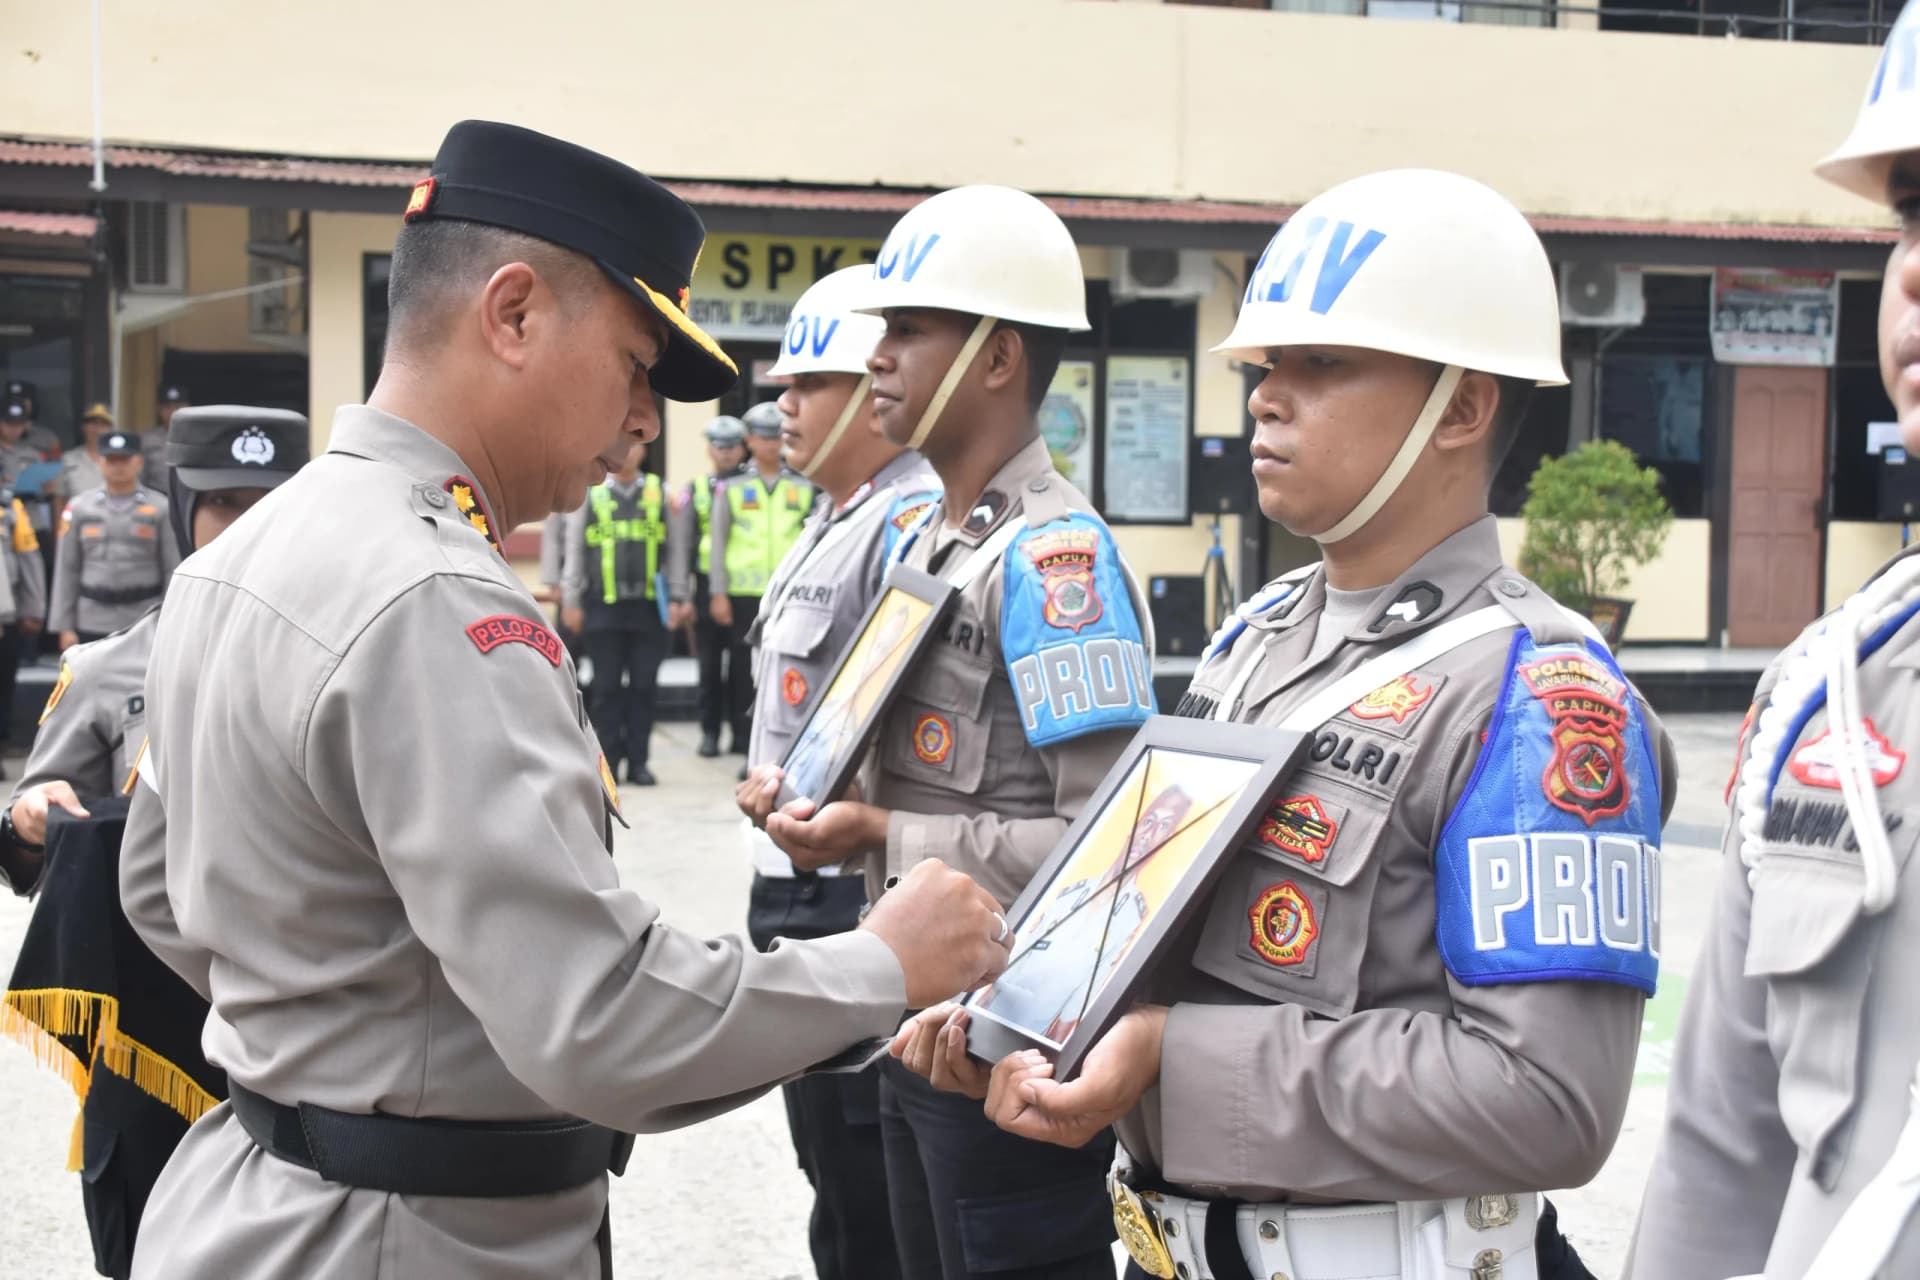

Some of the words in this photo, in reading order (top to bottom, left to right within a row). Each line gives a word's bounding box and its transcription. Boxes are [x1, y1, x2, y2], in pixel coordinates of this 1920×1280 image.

[1042, 553, 1090, 569] PAPUA
[475, 620, 557, 657] PELOPOR
[1010, 638, 1152, 731] PROV
[1536, 674, 1588, 692] JAYAPURA
[1554, 700, 1617, 720] PAPUA
[1259, 941, 1294, 958] PROPAM
